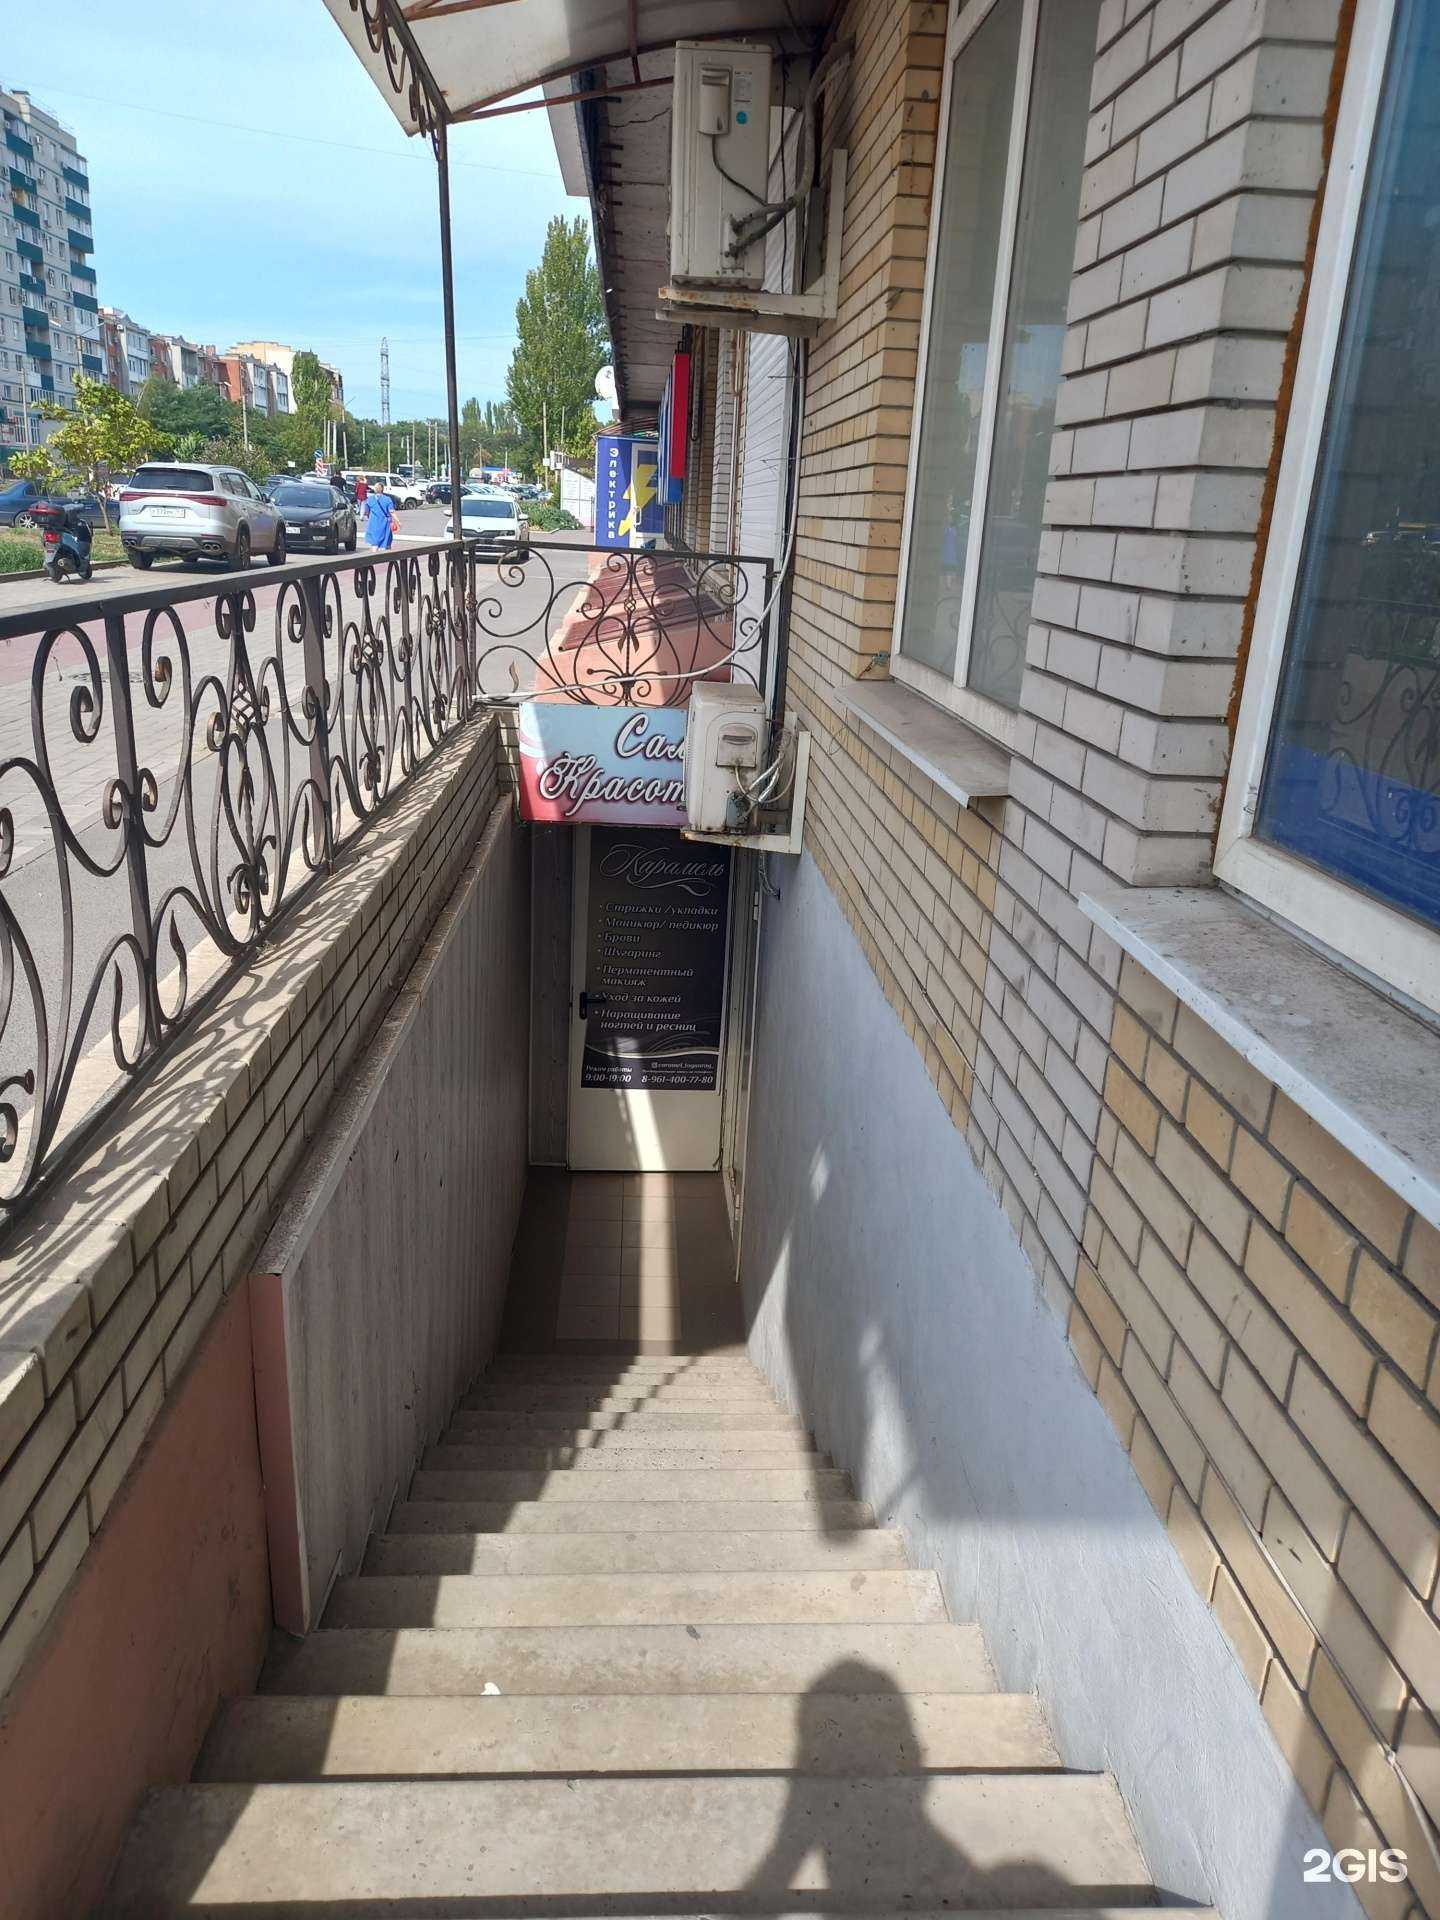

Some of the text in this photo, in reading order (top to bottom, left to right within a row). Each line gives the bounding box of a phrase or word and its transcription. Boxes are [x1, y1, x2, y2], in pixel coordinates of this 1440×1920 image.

[607, 447, 619, 539] Электрика
[599, 843, 725, 889] Карамель
[606, 903, 662, 915] Стрижки
[668, 920, 719, 933] педикюр
[604, 931, 641, 944] Брови
[603, 946, 663, 960] Шугаринг
[602, 964, 695, 978] Перманентный
[601, 977, 647, 987] макияж
[647, 994, 682, 1004] кожей
[600, 1008, 681, 1021] Наращивание
[600, 1020, 697, 1033] ногтей и ресниц
